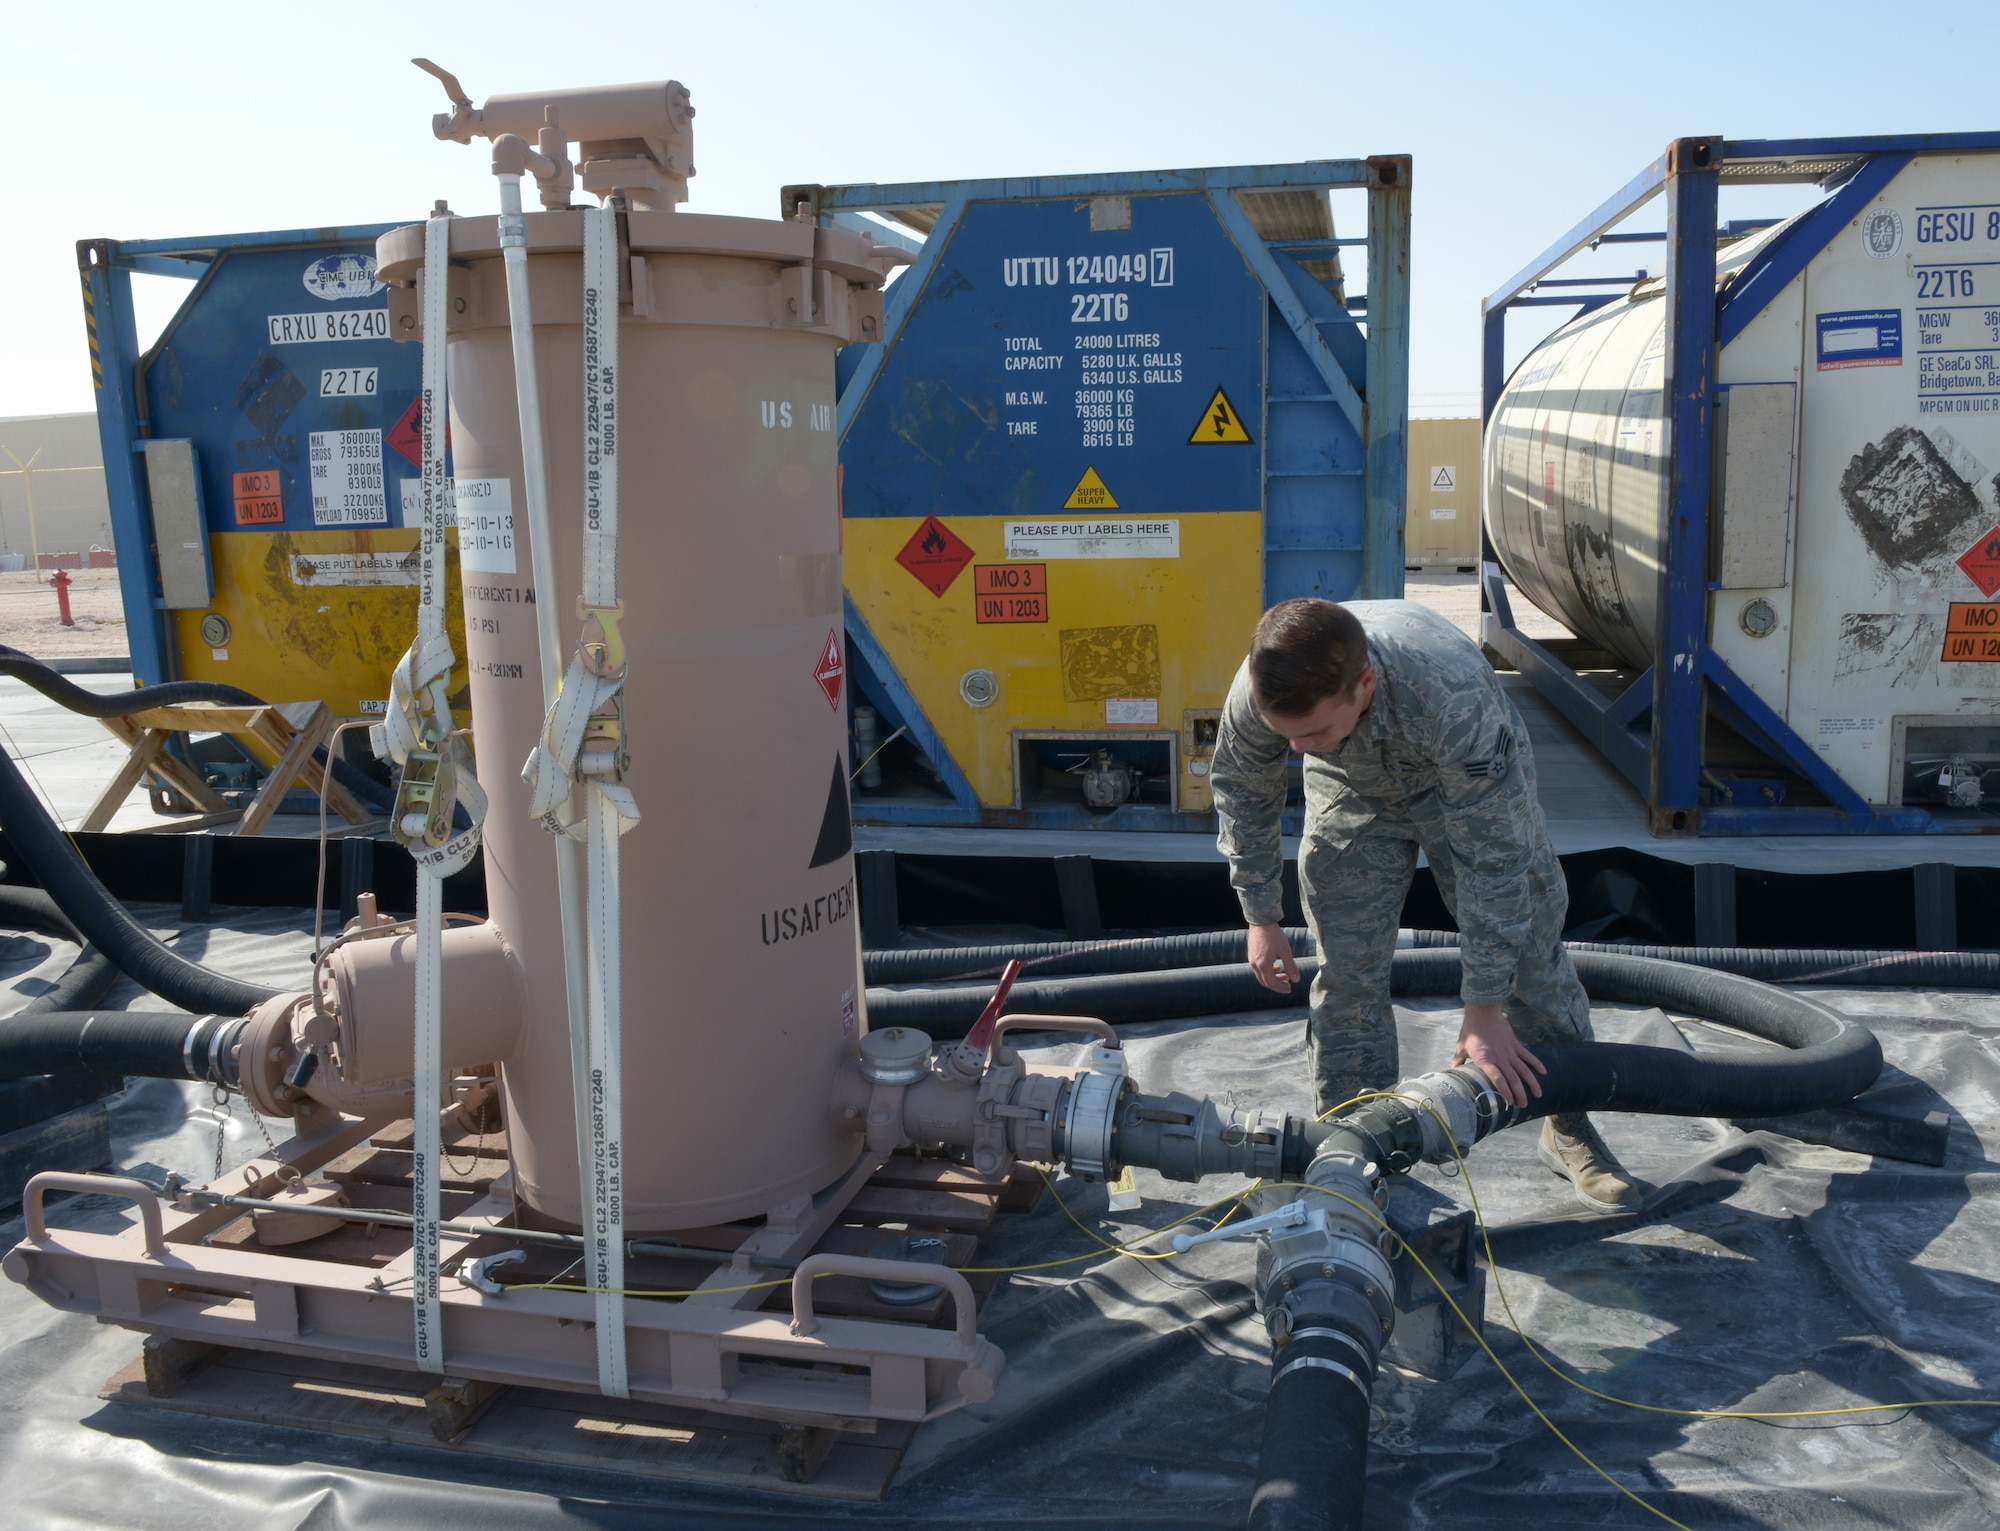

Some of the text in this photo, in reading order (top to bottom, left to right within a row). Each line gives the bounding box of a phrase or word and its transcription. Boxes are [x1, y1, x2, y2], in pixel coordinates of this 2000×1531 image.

[1917, 212, 1974, 243] GESU
[1004, 252, 1169, 286] UTTU 124049 7
[1916, 270, 1974, 298] 22T6
[1071, 293, 1128, 322] 22T6
[271, 316, 316, 342] CRXU
[1918, 313, 1951, 328] MGW
[1004, 334, 1160, 351] TOTAL 24000 LITRES
[1920, 328, 2000, 344] Tare 3
[1005, 352, 1182, 370] CAPACITY 5280 U.K. GALLS
[1920, 355, 2000, 372] GE SeaCo SRL.
[322, 370, 376, 394] 22T6
[1082, 369, 1182, 385] 6340 U.S. GALLS
[1920, 373, 1985, 392] Bridgetown,
[1006, 389, 1134, 406] M.G.W. 36000 KG
[1920, 400, 1954, 413] MPGM
[1956, 400, 1970, 412] ON
[1973, 399, 1990, 412] UIC
[603, 366, 615, 456] 5000 LB. CAP.
[761, 400, 831, 432] US AIR
[1075, 404, 1133, 418] 79365 LB
[1007, 418, 1134, 435] TARE 3900 KG
[311, 434, 324, 448] MAX
[1083, 433, 1134, 447] 8615 LB
[312, 448, 332, 461] GROSS
[588, 436, 600, 466] CL2
[312, 466, 328, 478] TARE
[242, 475, 270, 492] IMO 3
[1078, 488, 1104, 496] SUPER
[314, 496, 328, 508] MAX
[588, 469, 600, 531] CGU-1/B
[1078, 496, 1104, 504] HEAVY
[239, 502, 278, 520] UN 1203
[316, 509, 342, 522] PAYLOAD
[435, 513, 444, 544] 5000
[1014, 524, 1170, 536] PLEASE PUT LABELS HERE
[424, 528, 433, 556] CL2
[334, 560, 352, 569] PUT
[355, 558, 393, 569] LABELS
[423, 560, 432, 606] GU-1/B
[990, 570, 1031, 588] IMO 3
[1988, 577, 1994, 586] 3
[936, 584, 942, 592] 3
[984, 600, 1040, 618] UN 1203
[1965, 608, 1998, 626] IMO
[482, 618, 500, 634] PSI
[1952, 639, 1975, 656] UN
[360, 700, 378, 712] CAP.
[609, 1141, 620, 1225] 5000 LB. CAP.
[596, 1208, 607, 1234] CL2
[429, 1220, 438, 1299] 5000 LB. CAP.
[416, 1280, 426, 1306] CL2
[417, 1308, 428, 1358] CGU-1/B
